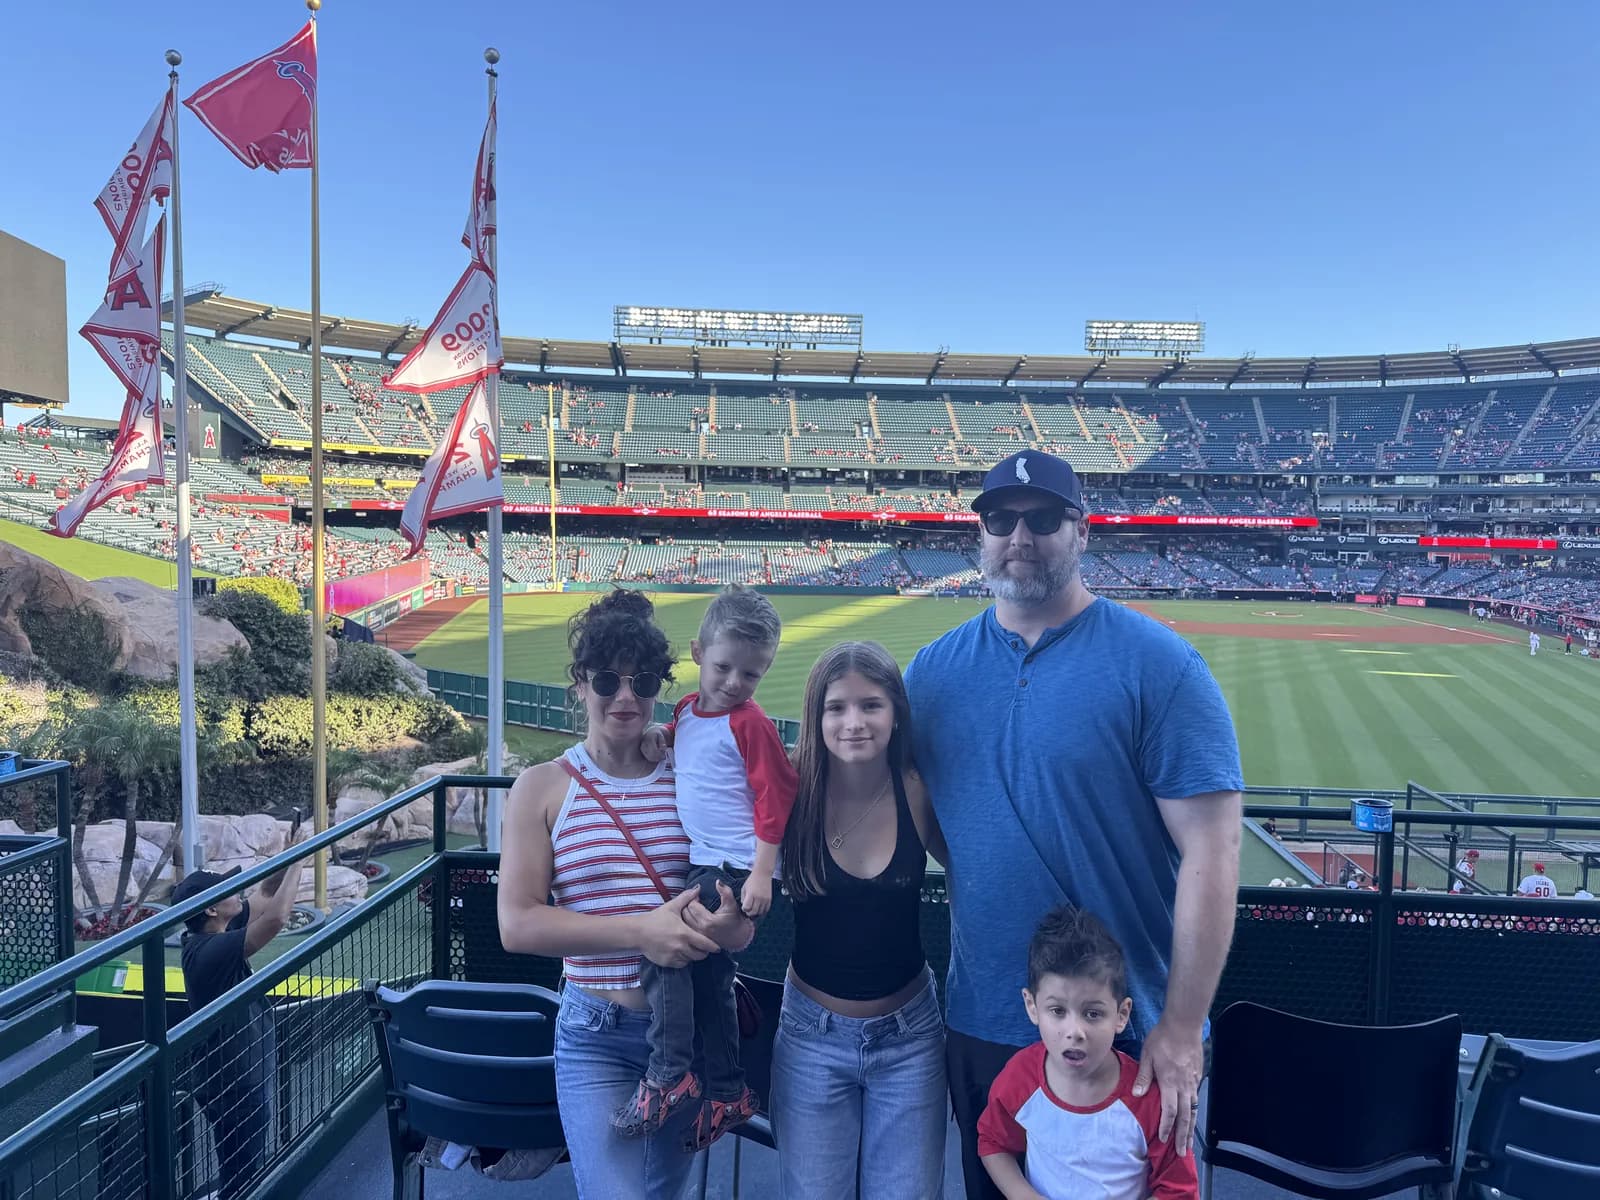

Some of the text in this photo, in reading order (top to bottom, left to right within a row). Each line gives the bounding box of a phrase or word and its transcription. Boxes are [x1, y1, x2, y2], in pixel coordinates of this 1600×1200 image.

[544, 506, 581, 514] BEBALL
[718, 510, 749, 518] SEASONS
[788, 511, 823, 519] BASEBALL
[1188, 517, 1218, 525] SEASONS
[1257, 518, 1293, 526] BASEBALL
[1535, 887, 1550, 897] 90
